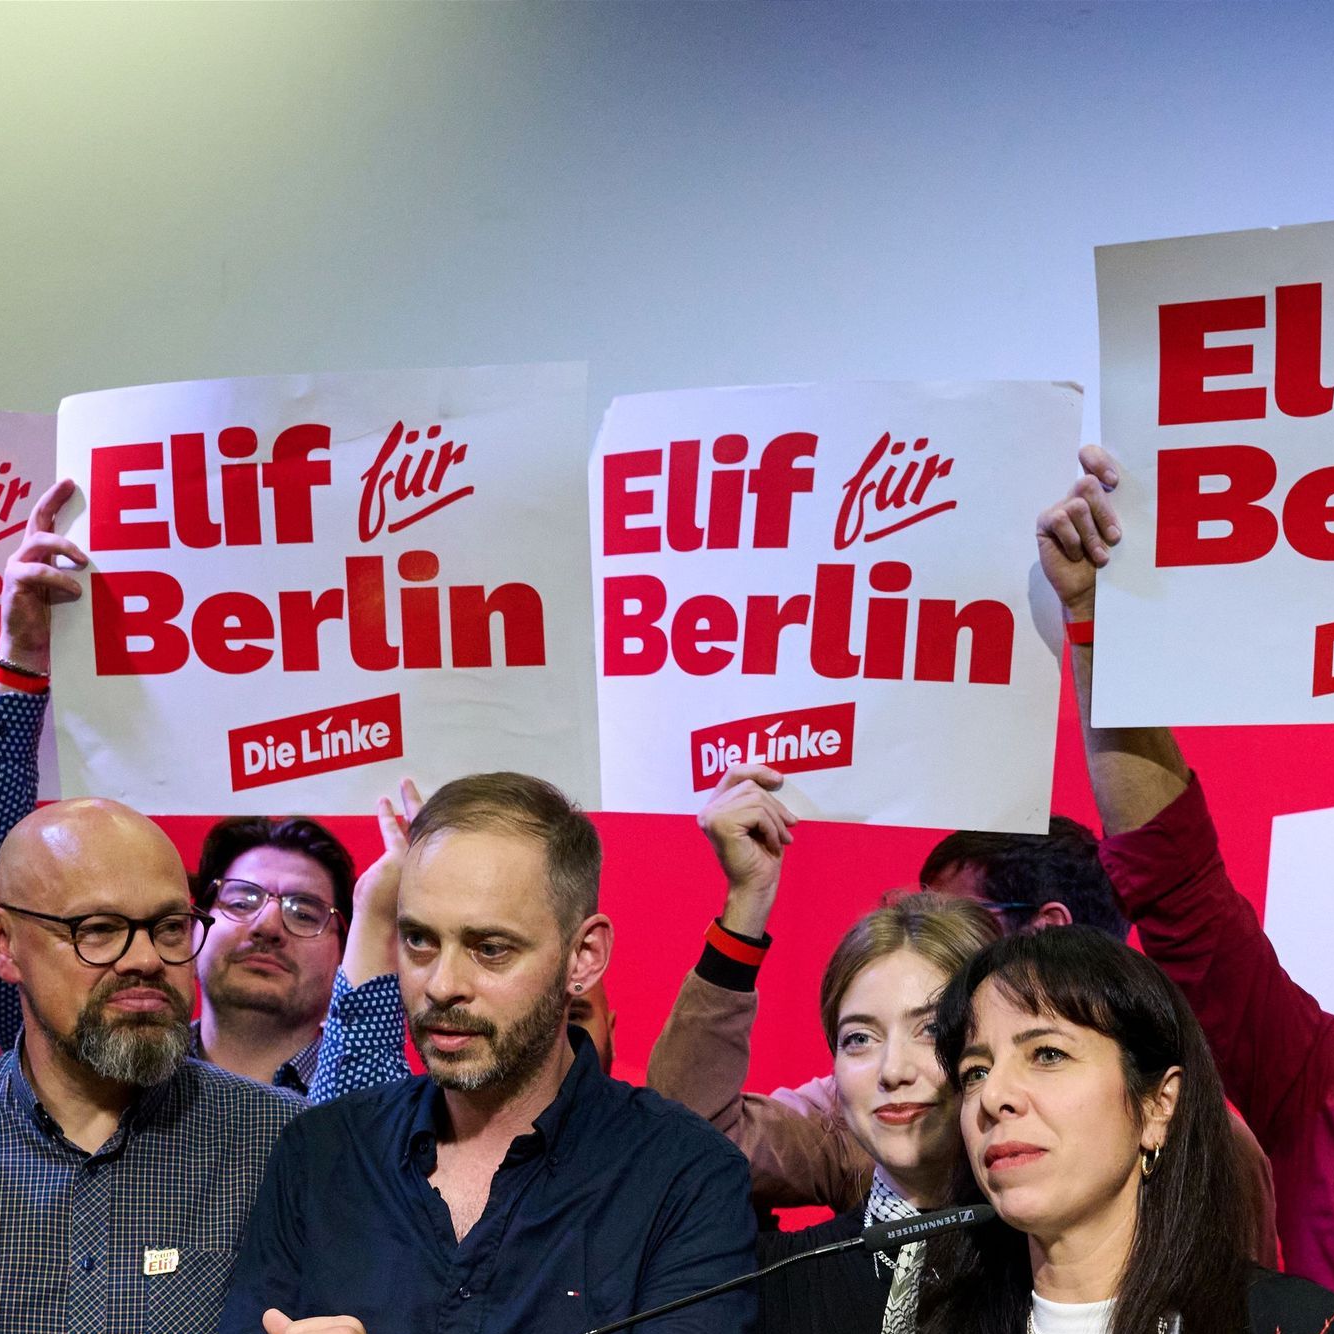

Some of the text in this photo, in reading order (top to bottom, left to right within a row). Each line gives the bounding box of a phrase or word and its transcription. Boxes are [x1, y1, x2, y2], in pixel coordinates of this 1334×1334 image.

[89, 421, 469, 552] Elif für
[603, 431, 955, 556] Elif für
[89, 550, 547, 677] Berlin
[603, 560, 1015, 686] Berlin
[242, 716, 391, 776] Die Linke
[700, 720, 842, 777] Die Linke
[886, 1214, 957, 1240] SENNHEISER
